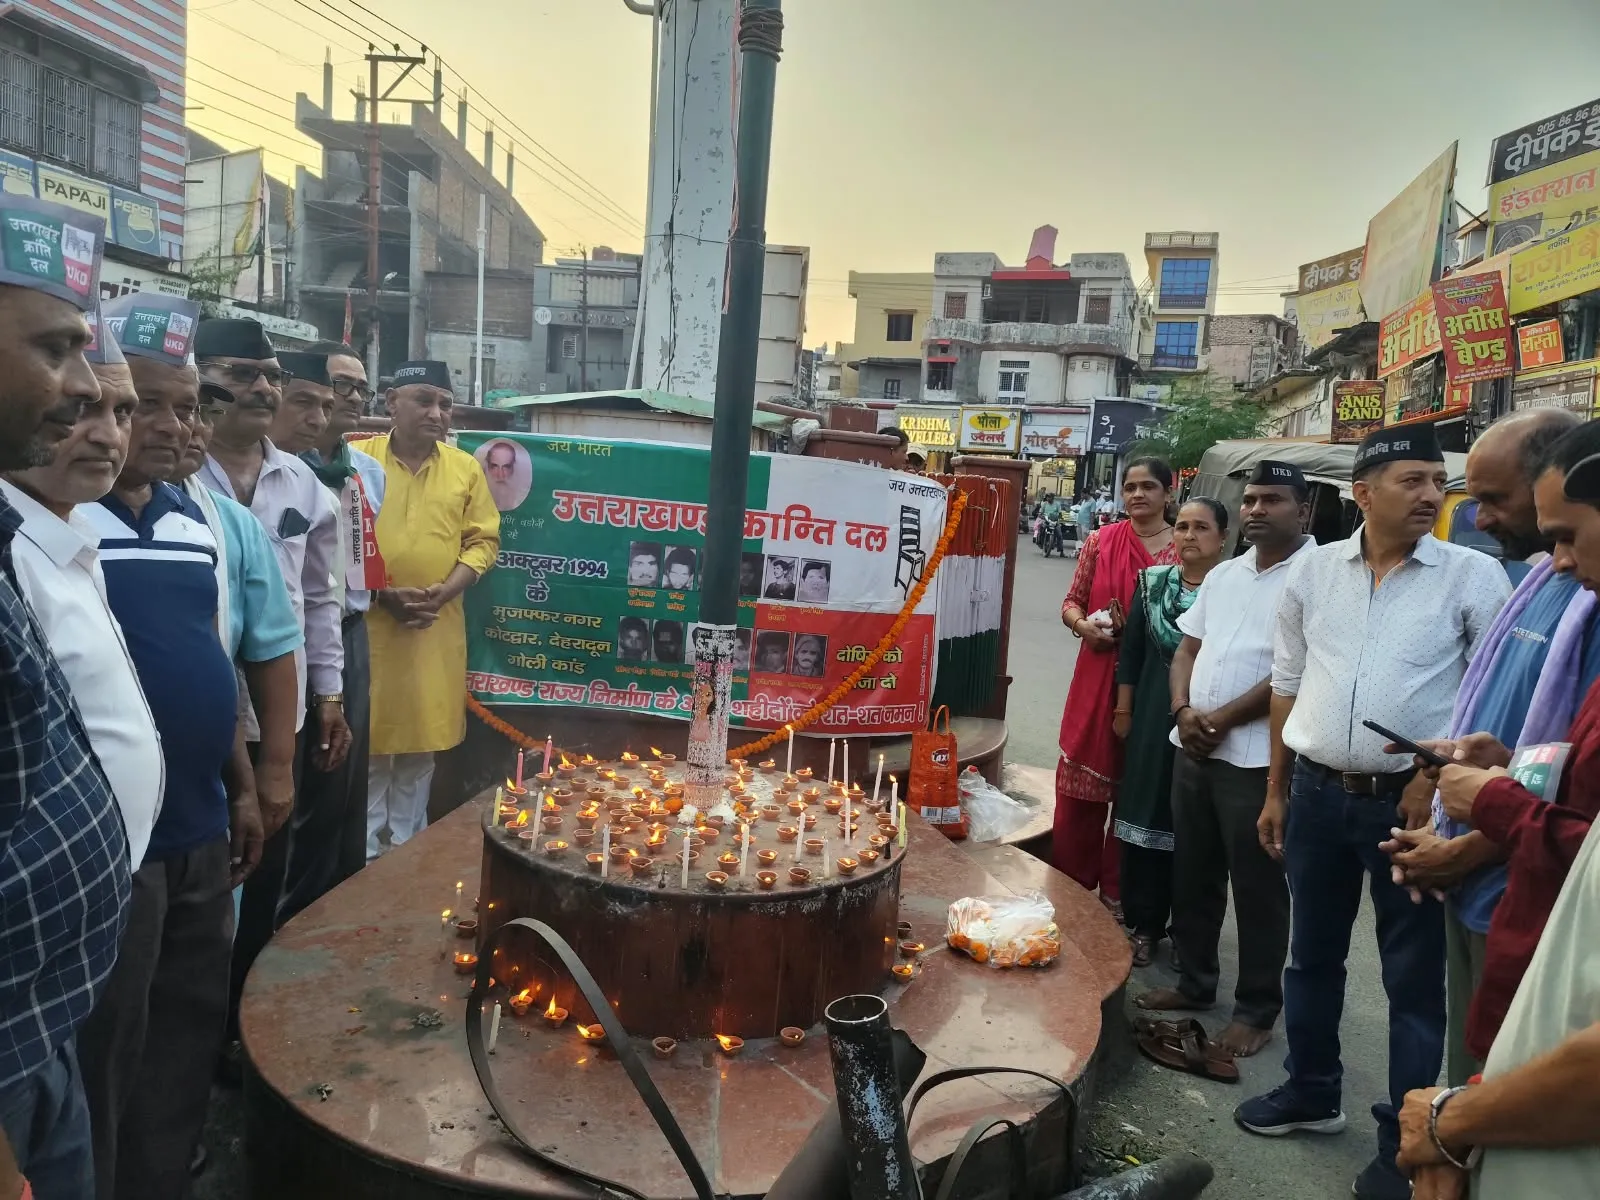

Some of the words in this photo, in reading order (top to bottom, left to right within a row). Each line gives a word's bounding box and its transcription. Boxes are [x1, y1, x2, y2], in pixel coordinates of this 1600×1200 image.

[1536, 119, 1557, 136] 905
[1558, 113, 1573, 128] 86
[1574, 107, 1590, 122] 86
[1504, 122, 1582, 173] दीपक
[43, 177, 107, 211] PAPAJI
[113, 199, 153, 219] PEPSI
[29, 257, 50, 275] दल
[65, 264, 90, 287] UKD
[1303, 262, 1345, 290] दीपक
[1443, 305, 1506, 337] अनीस
[138, 334, 152, 345] दल
[164, 337, 185, 351] UKD
[1520, 330, 1559, 353] रास्ता
[1450, 337, 1507, 366] बैण्ड
[1338, 394, 1381, 409] ANIS
[977, 411, 1002, 429] भोला
[1336, 407, 1384, 421] BAND
[899, 416, 951, 432] KRISHNA
[905, 430, 956, 446] WELLERS
[1392, 440, 1411, 451] दल
[546, 439, 571, 454] जय
[575, 441, 614, 457] भारत
[1271, 467, 1292, 477] UKD
[888, 479, 906, 493] जय
[844, 521, 890, 553] दल
[568, 558, 609, 579] 1994
[525, 580, 551, 603] के
[563, 613, 603, 629] नगर
[548, 631, 613, 658] देहरादून
[507, 652, 548, 670] गोली
[551, 658, 587, 676] कांड
[702, 654, 715, 662] FOR
[882, 646, 904, 663] को
[879, 672, 898, 690] दो
[538, 681, 586, 702] राज्य
[587, 678, 652, 709] निर्माण
[653, 685, 679, 711] के
[730, 692, 793, 722] शहीदों
[881, 704, 917, 725] नमन
